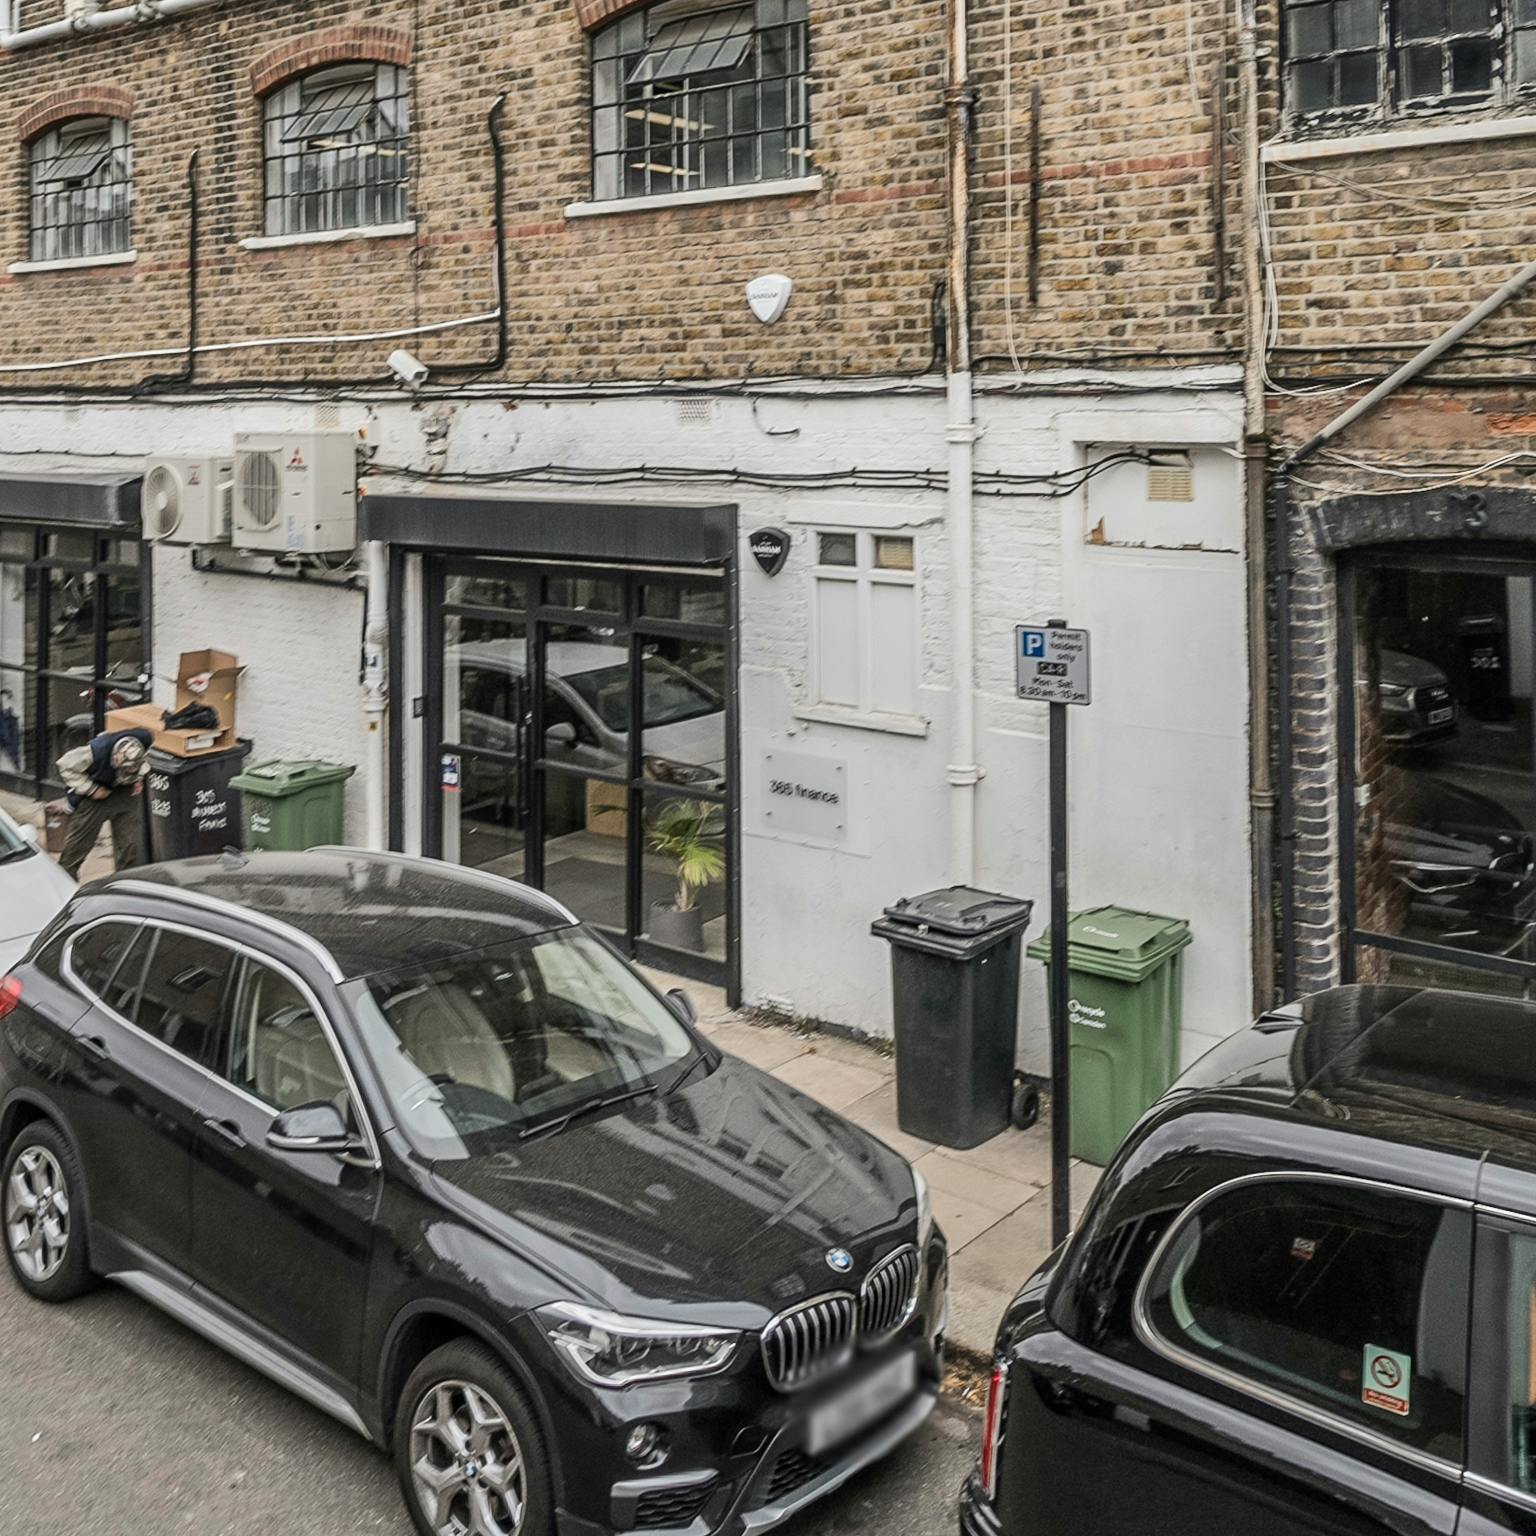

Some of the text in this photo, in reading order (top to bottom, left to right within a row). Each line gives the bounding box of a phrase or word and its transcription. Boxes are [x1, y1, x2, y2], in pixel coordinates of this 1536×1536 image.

[1026, 634, 1042, 655] P
[769, 779, 840, 804] 365 finance
